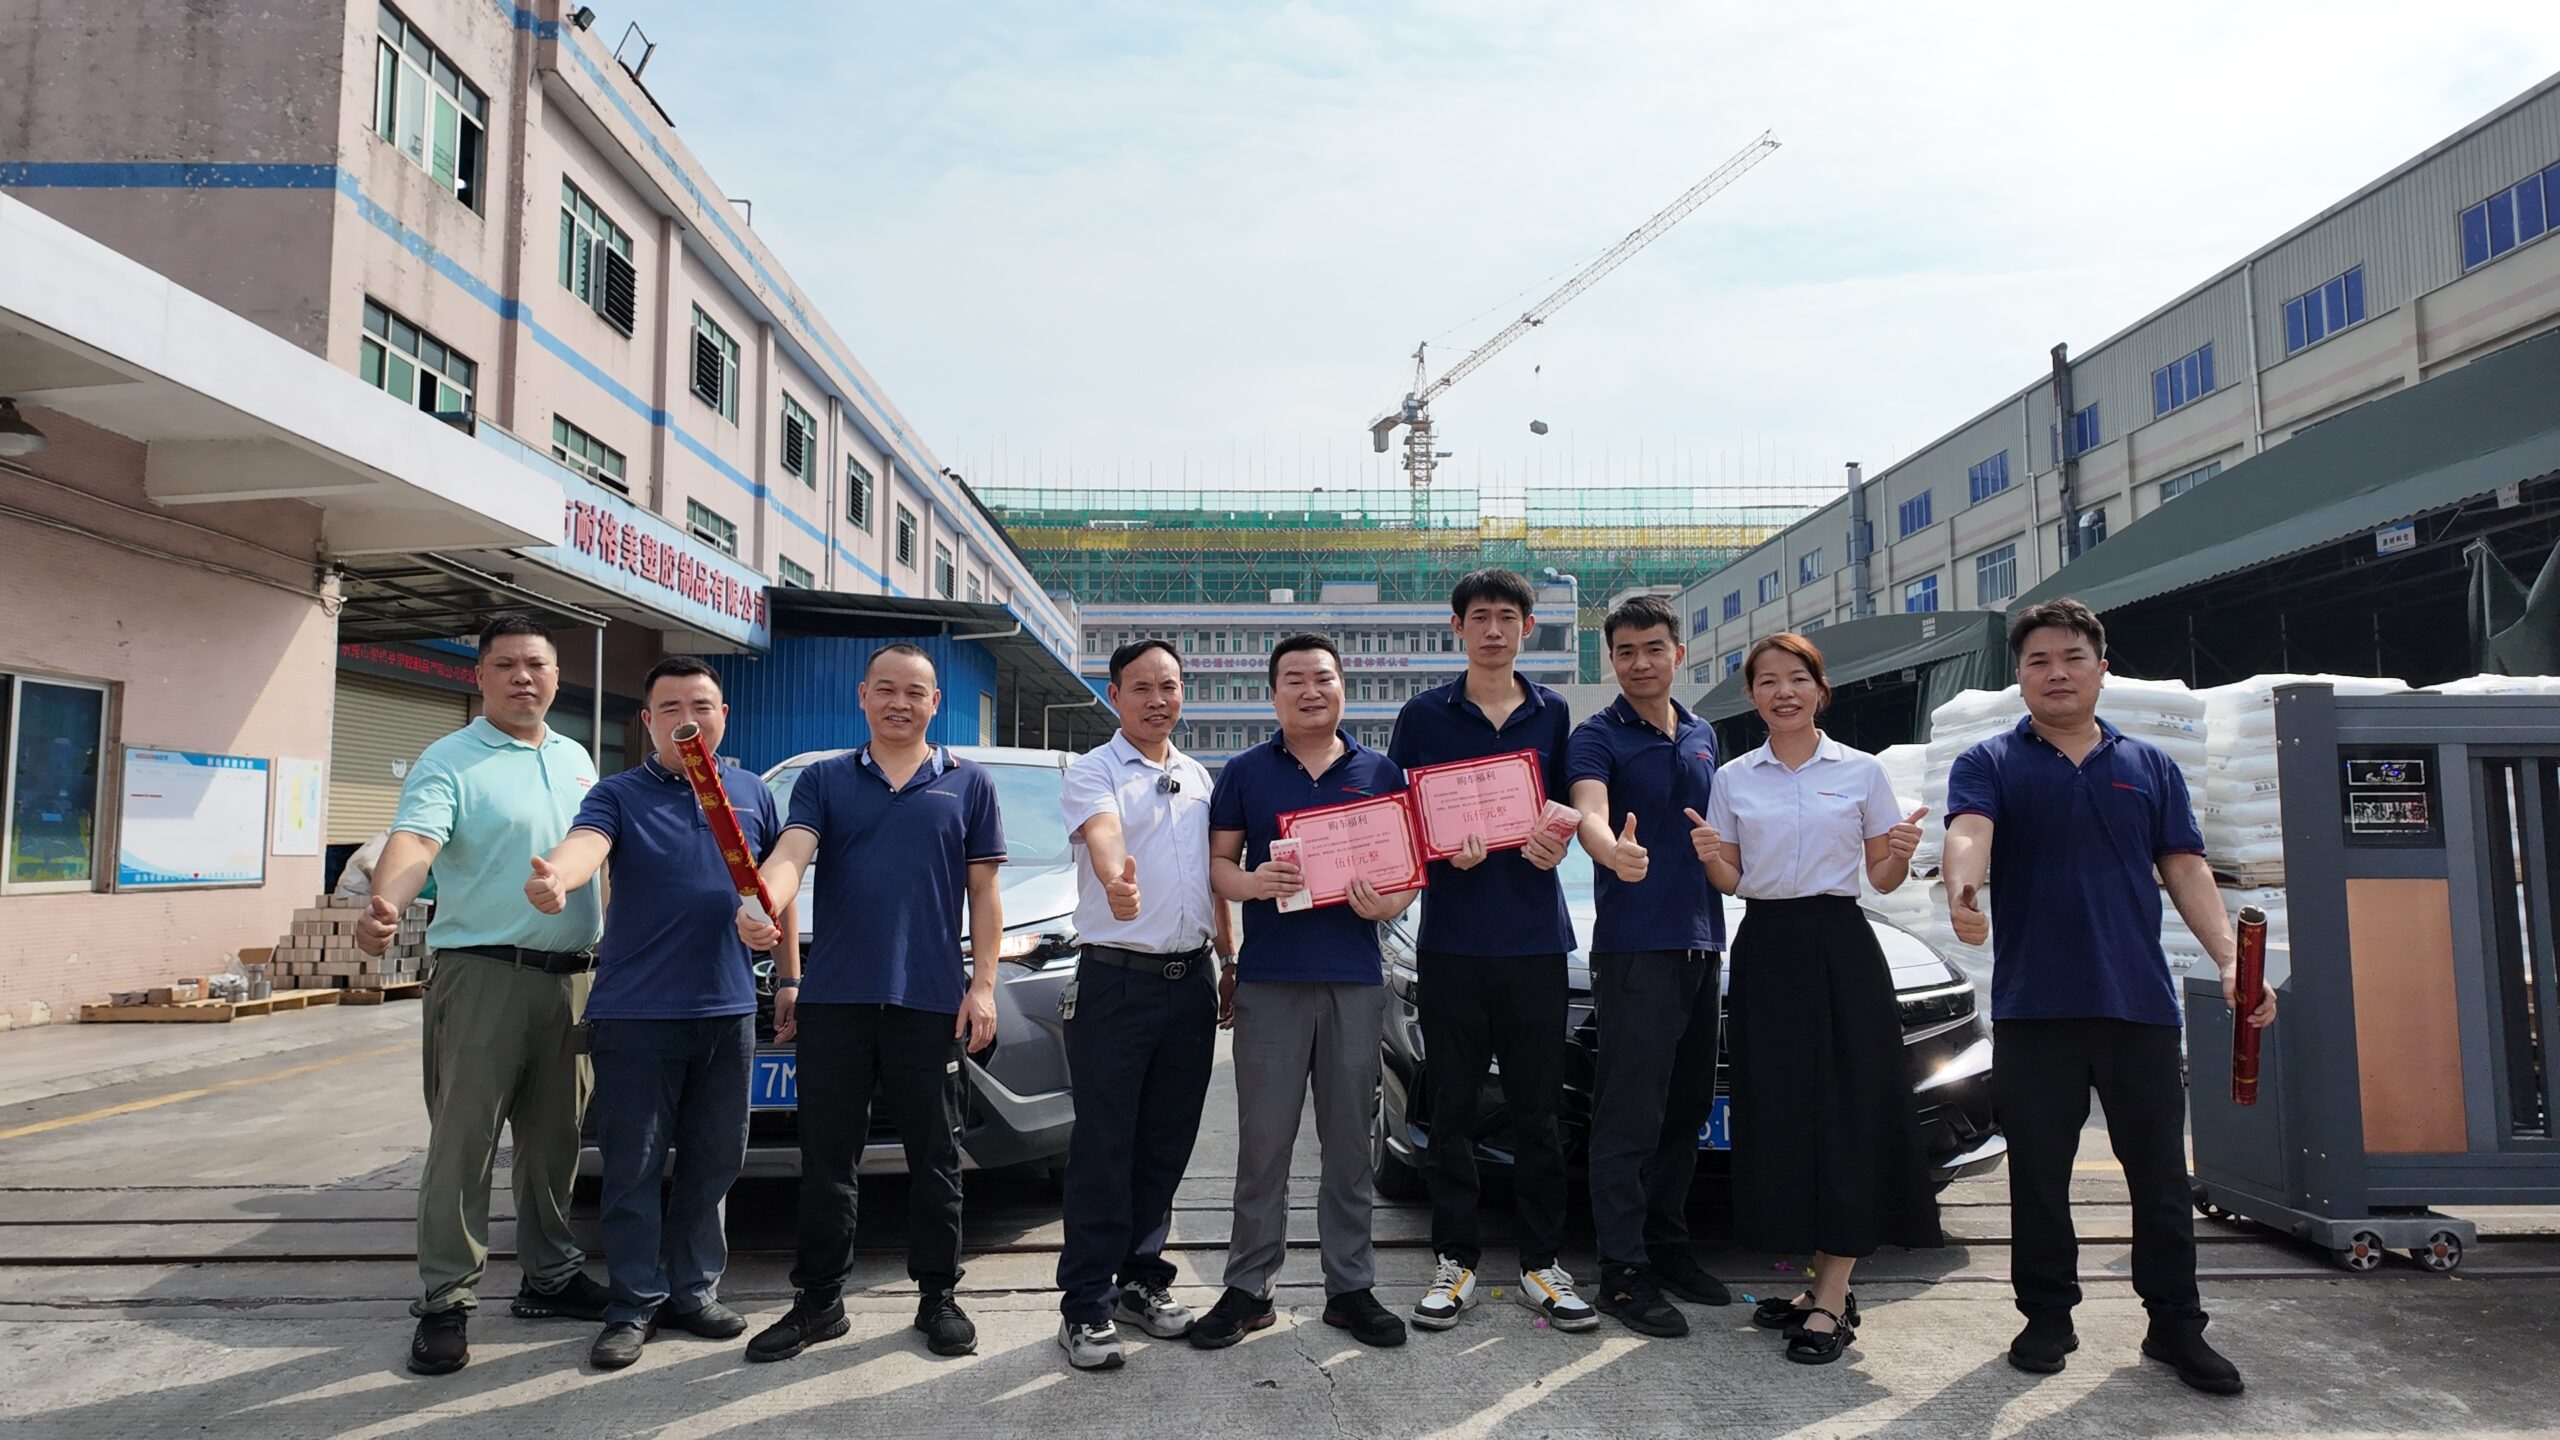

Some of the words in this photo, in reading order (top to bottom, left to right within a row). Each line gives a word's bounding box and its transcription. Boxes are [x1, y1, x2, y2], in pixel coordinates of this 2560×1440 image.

[1456, 770, 1496, 786] 购车福利
[1328, 814, 1368, 831] 购车福利
[1462, 805, 1508, 823] 伍仟元整
[1335, 850, 1381, 869] 伍仟元整
